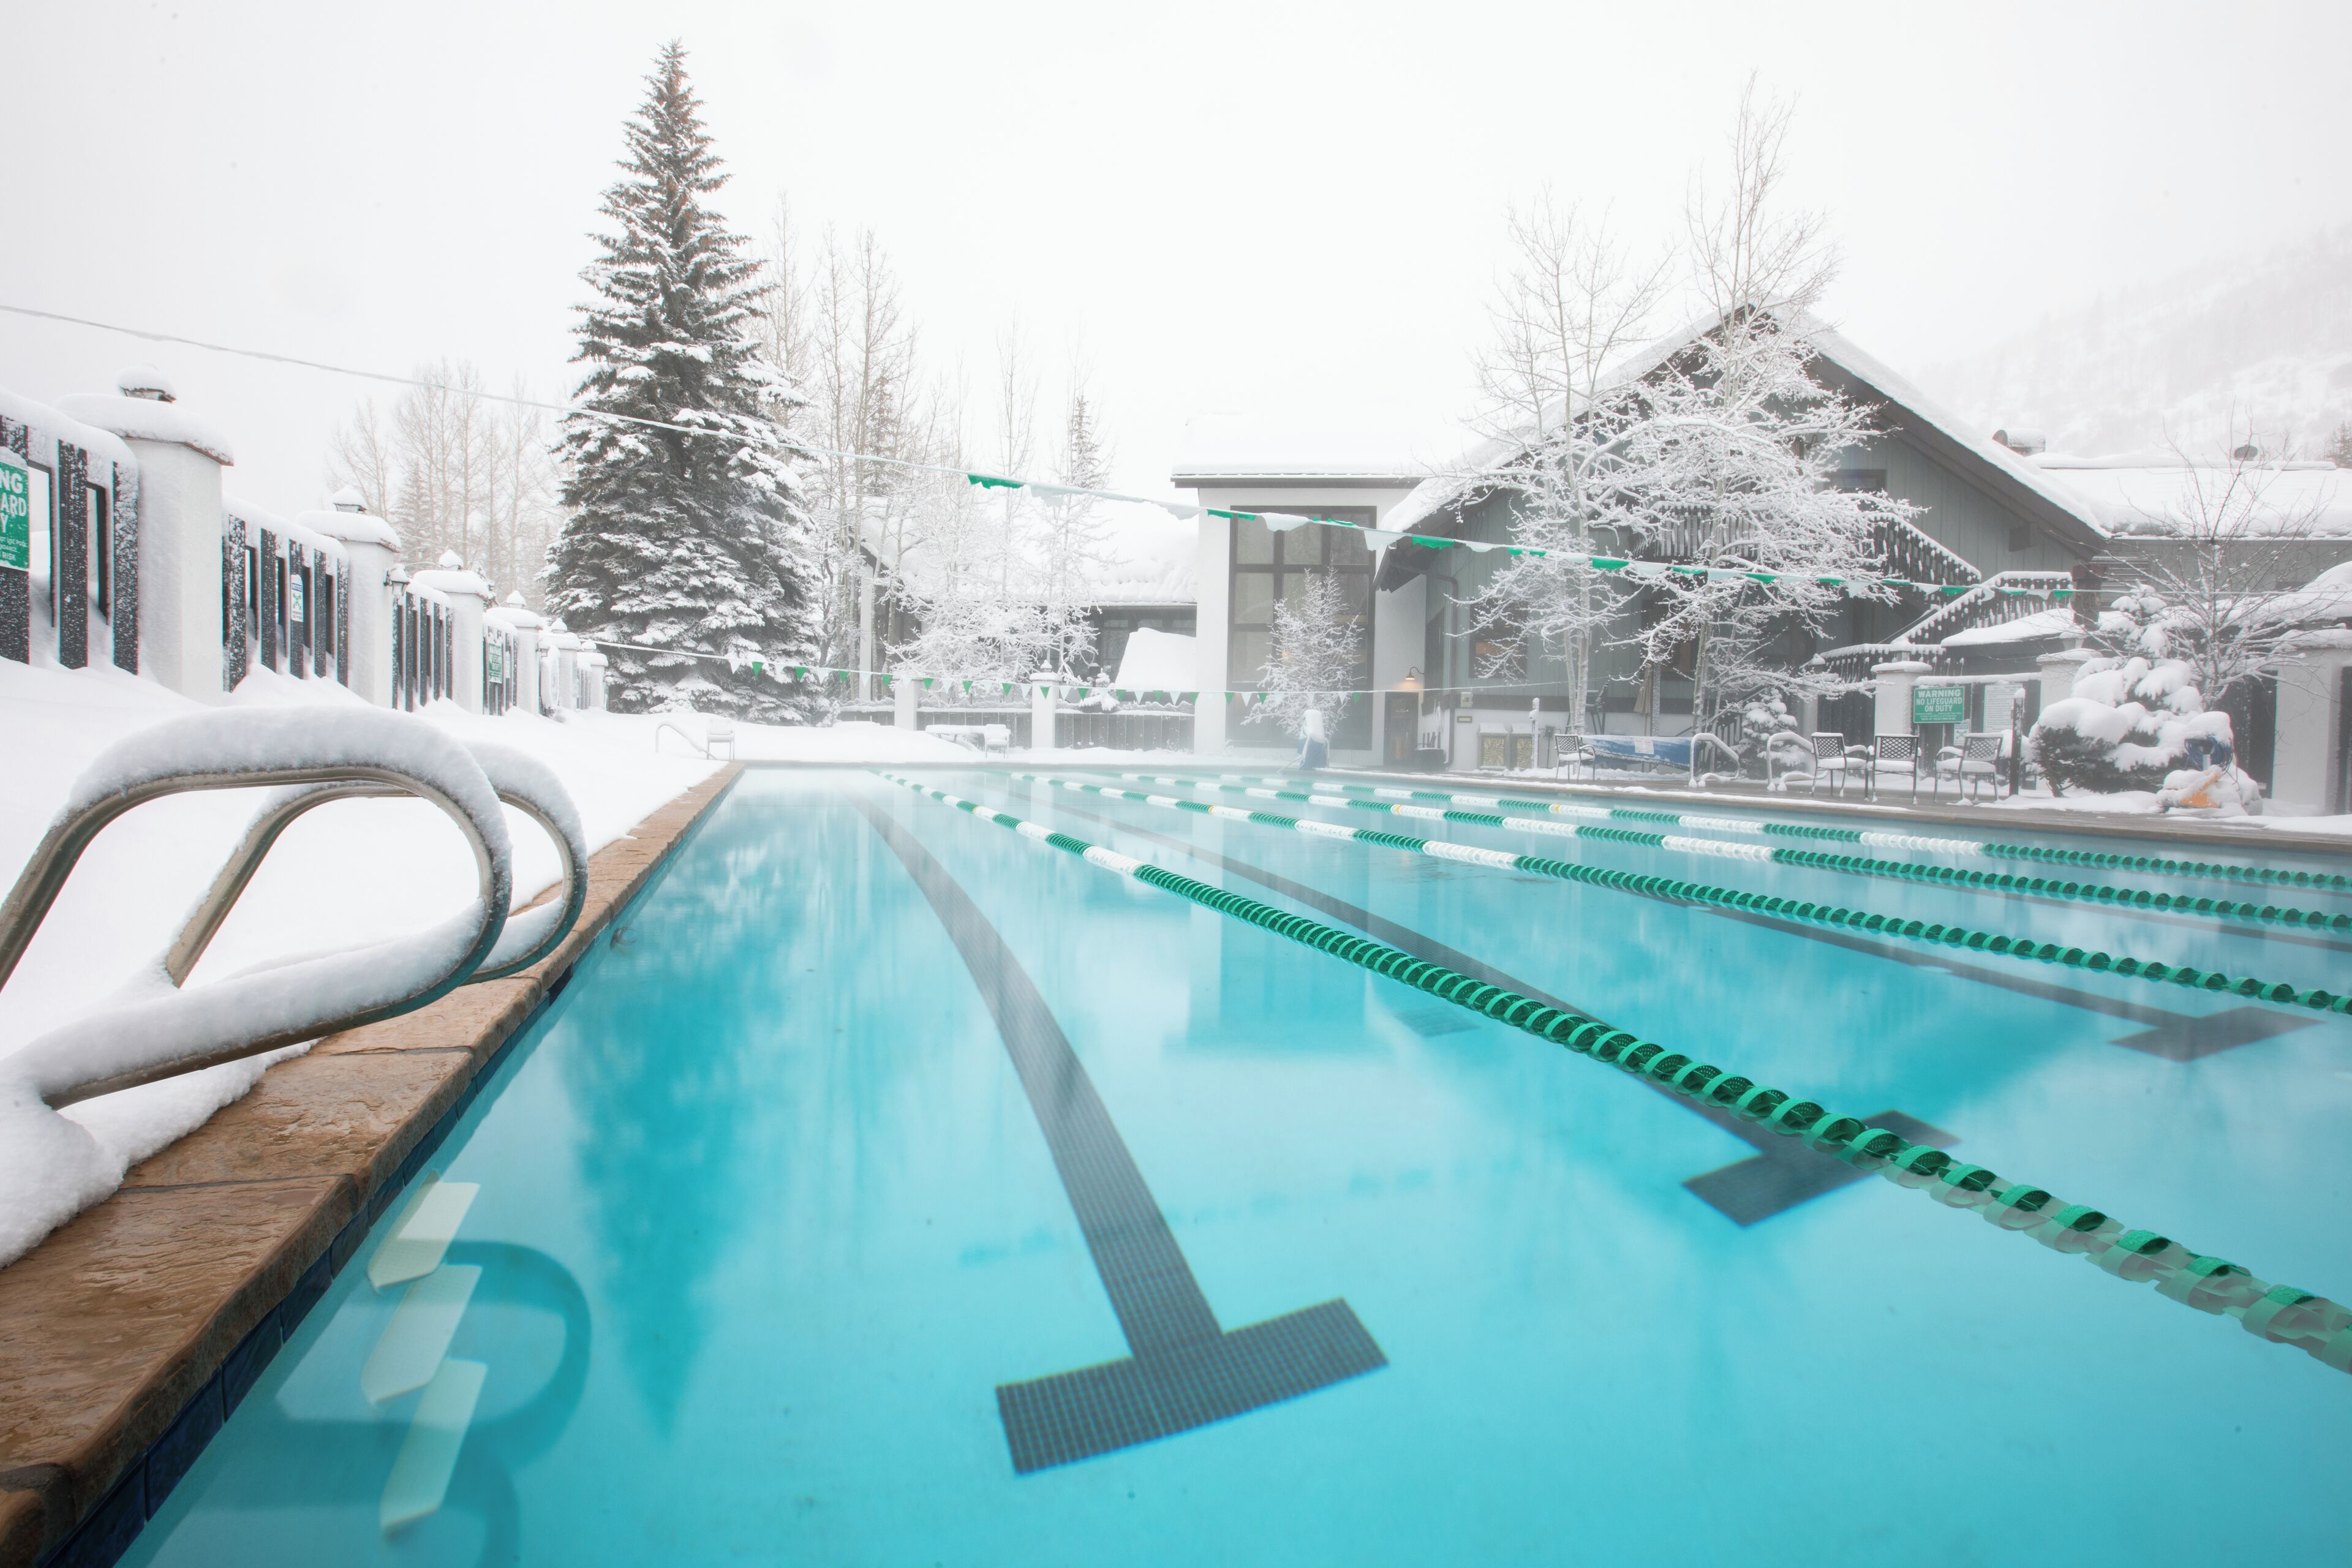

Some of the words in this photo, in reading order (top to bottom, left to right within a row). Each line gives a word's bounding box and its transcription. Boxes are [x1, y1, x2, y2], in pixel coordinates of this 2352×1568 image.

[0, 492, 26, 516] ARD
[1, 551, 16, 560] RISK
[1918, 689, 1961, 698] WARNING
